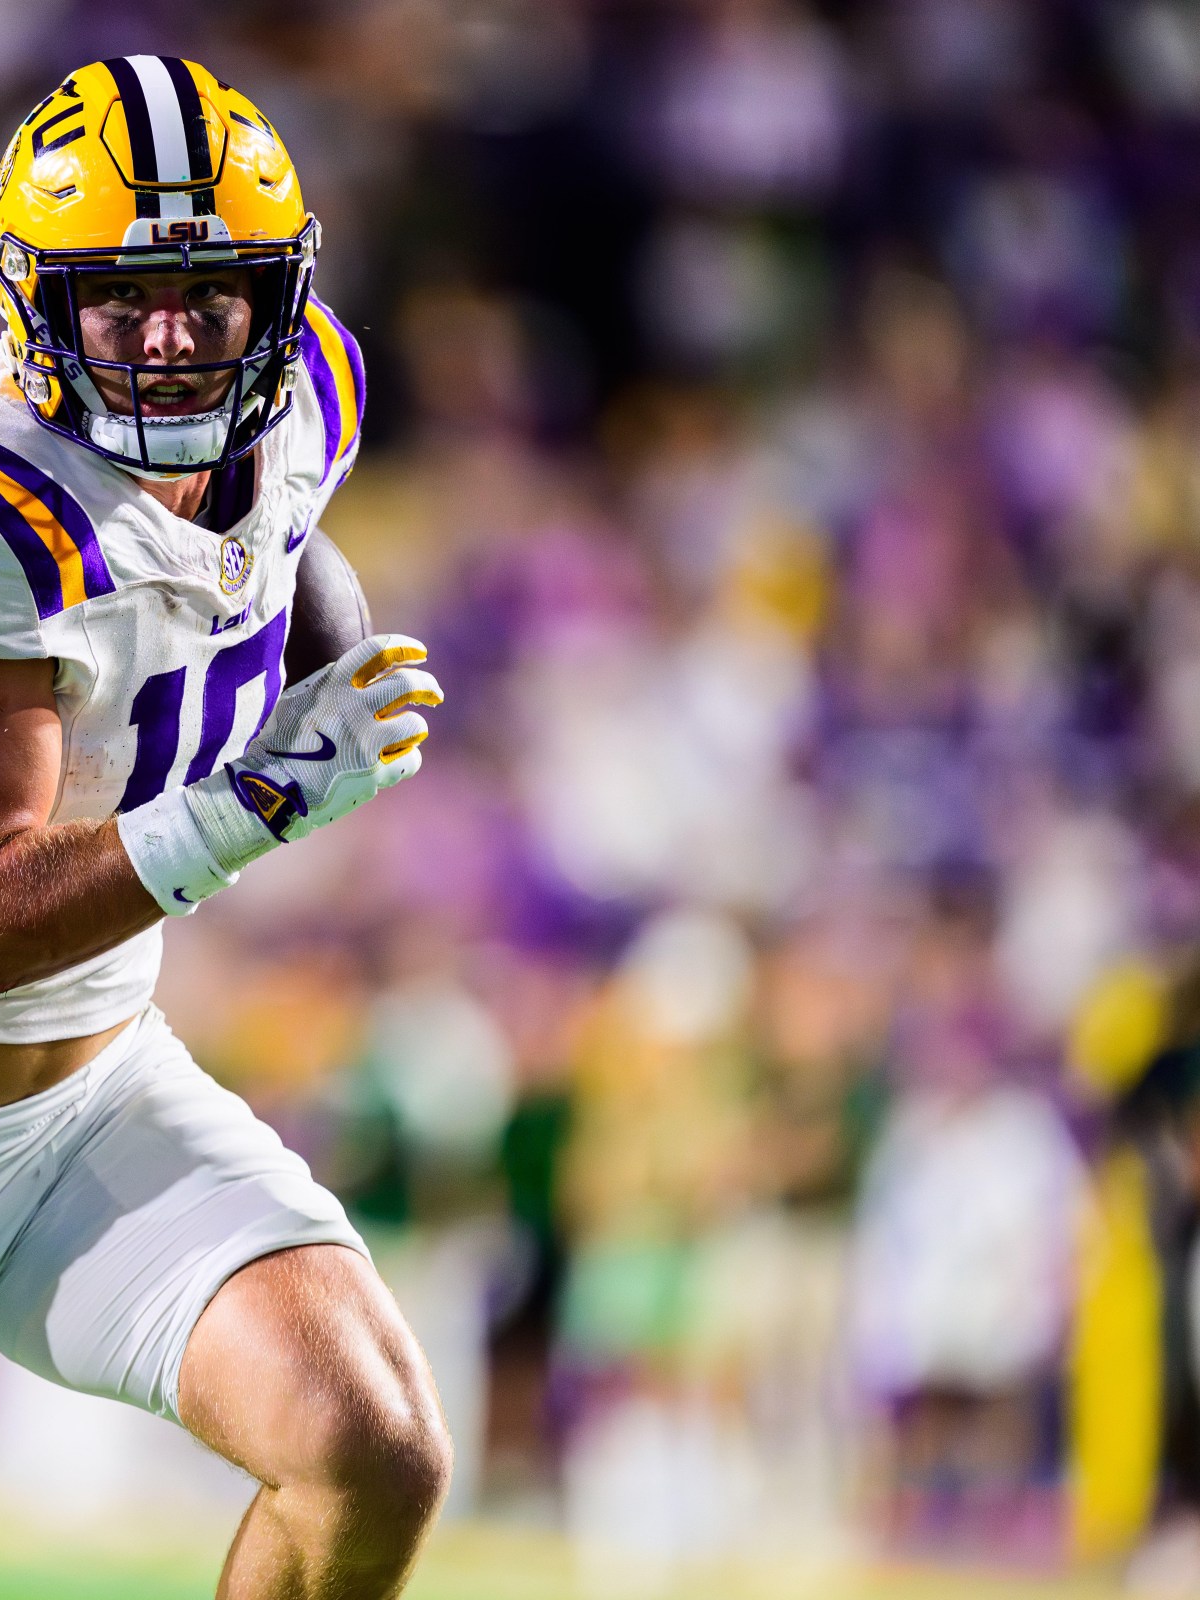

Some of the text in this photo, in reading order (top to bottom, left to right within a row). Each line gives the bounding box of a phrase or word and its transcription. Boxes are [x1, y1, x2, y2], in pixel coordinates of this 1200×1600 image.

[150, 220, 209, 244] LSU
[223, 540, 246, 581] SEC
[210, 595, 254, 634] LSU
[117, 606, 287, 813] 10
